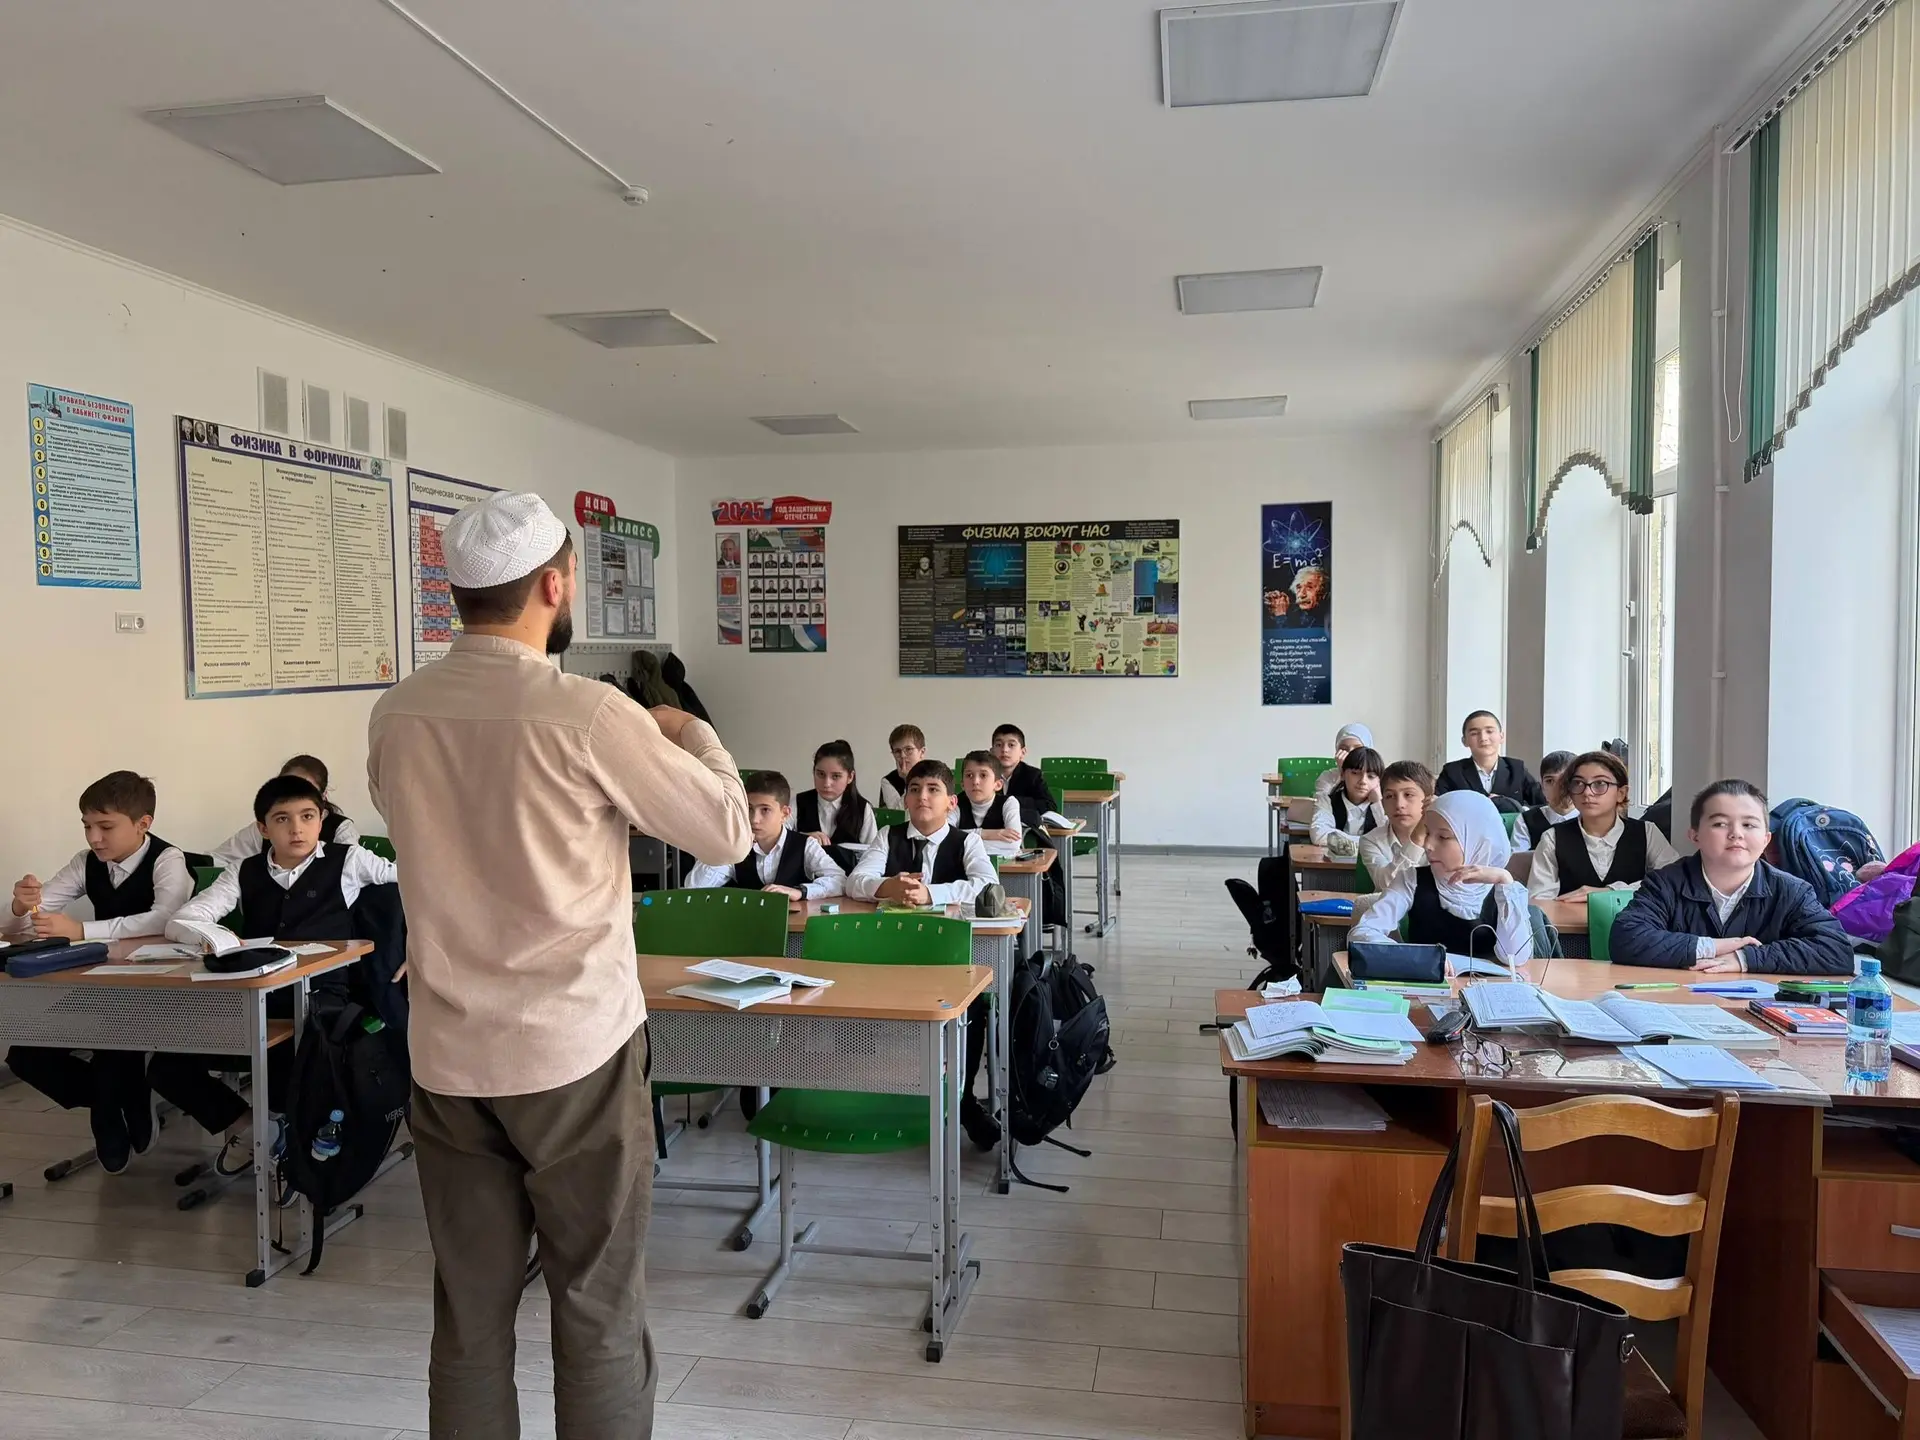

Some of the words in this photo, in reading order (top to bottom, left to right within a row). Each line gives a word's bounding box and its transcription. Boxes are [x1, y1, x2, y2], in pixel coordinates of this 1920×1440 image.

[59, 394, 86, 406] ПРАВИЛА
[87, 400, 130, 415] БЕЗОПАСНОСТИ
[72, 407, 101, 419] КАБИНЕТЕ
[102, 413, 126, 424] ФИЗИКИ
[230, 433, 282, 456] ФИЗИКА
[289, 444, 297, 458] В
[303, 448, 362, 471] ФОРМУЛАХ
[411, 481, 454, 498] Периодическая
[717, 501, 764, 522] 2025
[787, 505, 827, 513] ЗАЩИТНИКА
[961, 526, 1020, 540] ФИЗИКА
[1023, 525, 1079, 539] ВОКРУГ
[1081, 524, 1110, 538] НАС
